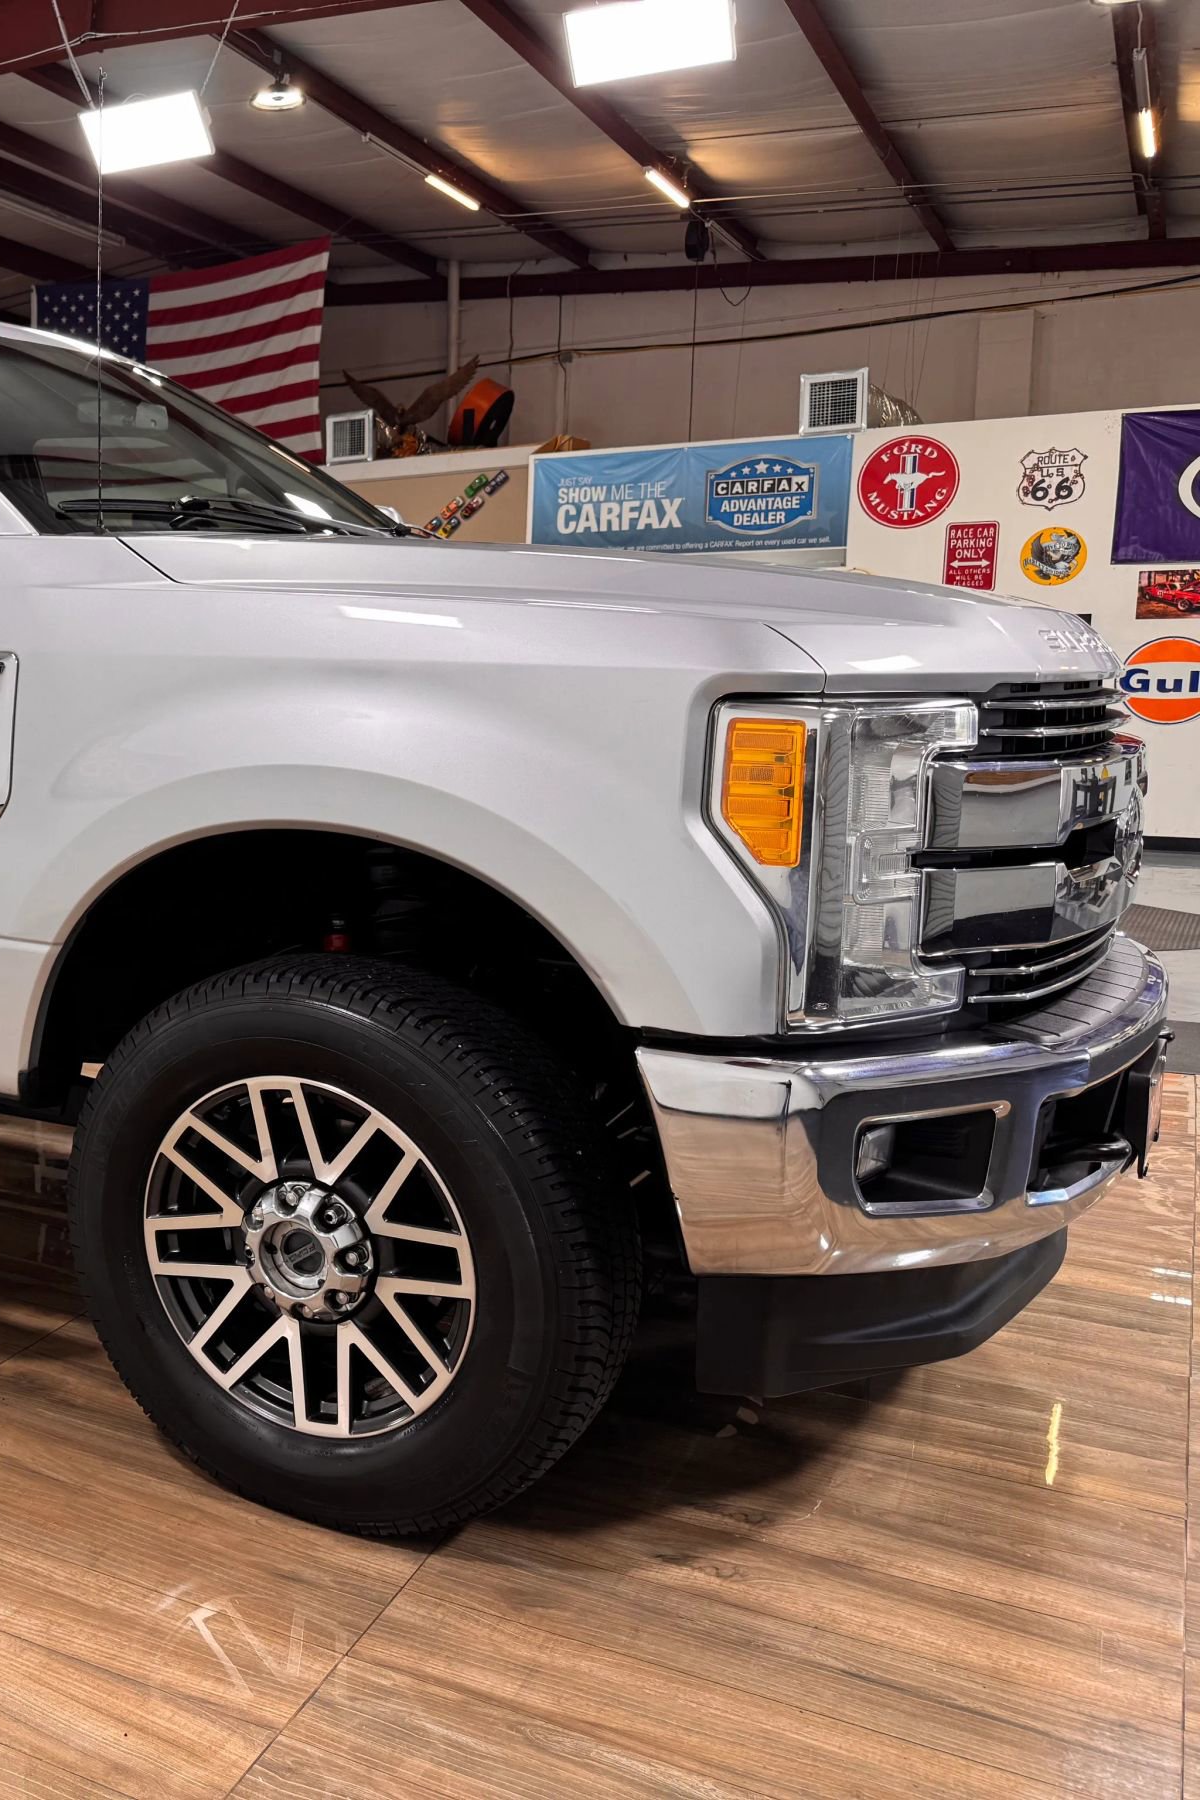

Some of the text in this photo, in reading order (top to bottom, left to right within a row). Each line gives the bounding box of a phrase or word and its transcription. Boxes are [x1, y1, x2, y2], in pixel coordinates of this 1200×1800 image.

[880, 441, 938, 463] FORD
[1037, 454, 1069, 465] ROUTE
[558, 476, 593, 487] JUST SAY
[715, 477, 807, 496] CARFAX
[558, 480, 667, 504] SHOW ME THE
[867, 487, 948, 521] MUSTANG
[556, 498, 683, 535] CARFAX
[733, 511, 786, 526] DEALER
[950, 526, 995, 539] RACE CAR
[646, 543, 675, 551] committed
[682, 542, 704, 550] offering
[735, 540, 754, 549] Report
[950, 537, 993, 549] PARKING
[955, 547, 986, 559] ONLY
[964, 567, 991, 575] OTHERS
